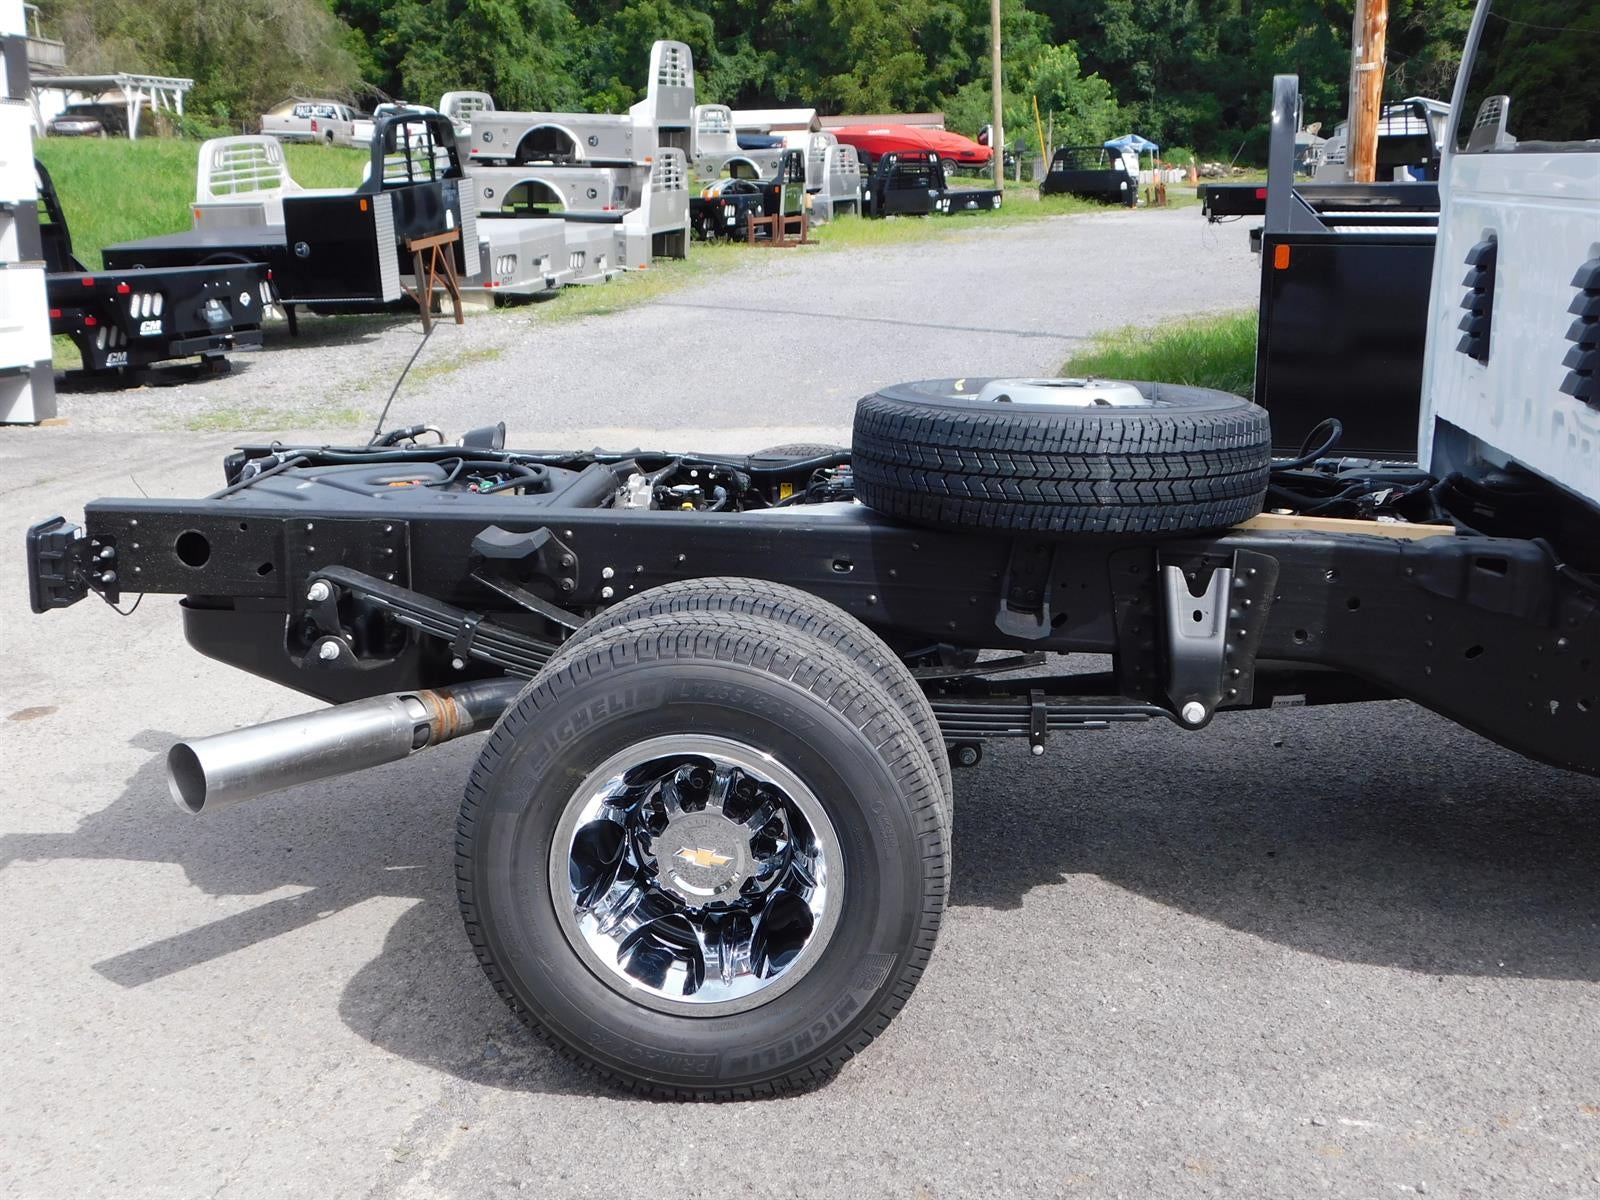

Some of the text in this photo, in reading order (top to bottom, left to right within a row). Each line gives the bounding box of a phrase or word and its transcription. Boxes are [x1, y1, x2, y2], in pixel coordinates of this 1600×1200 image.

[106, 351, 127, 362] CM
[529, 682, 658, 771] MICHELIN
[728, 992, 860, 1069] MICHELIN
